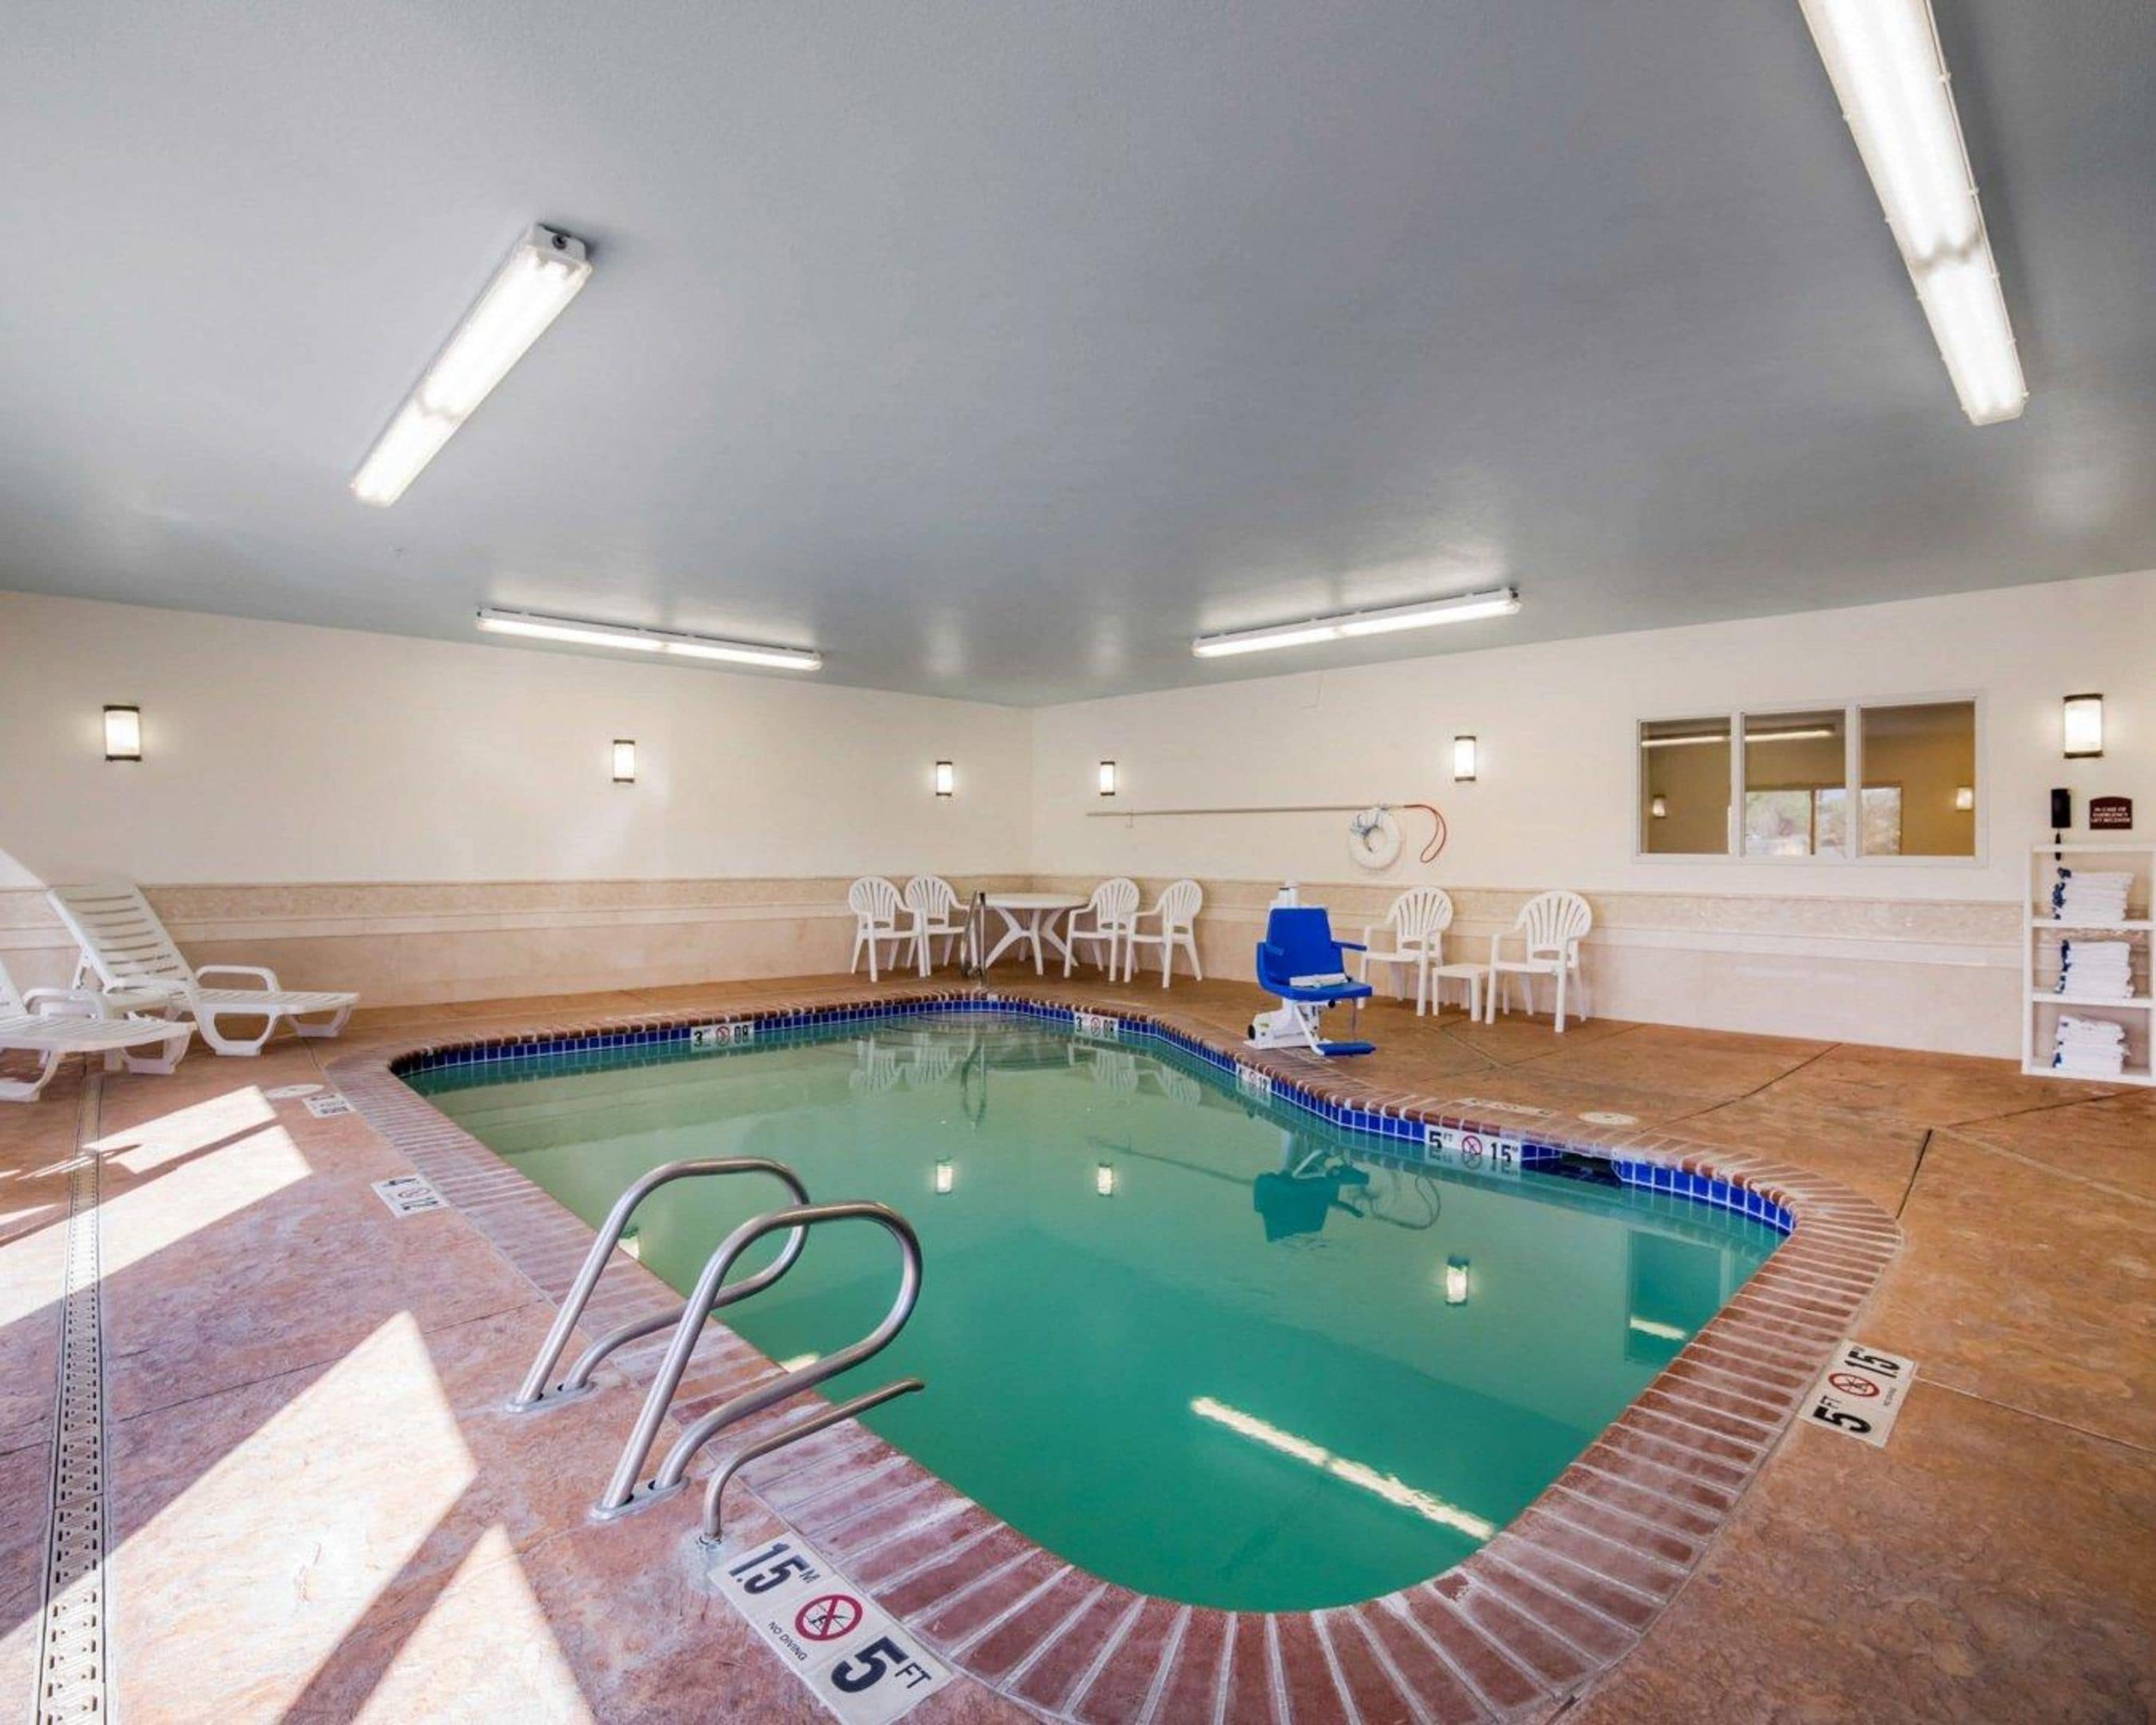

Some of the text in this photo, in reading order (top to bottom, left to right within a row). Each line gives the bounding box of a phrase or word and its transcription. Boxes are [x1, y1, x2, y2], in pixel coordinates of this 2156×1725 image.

[1429, 1131, 1443, 1149] 5
[1820, 1395, 1843, 1409] FT
[1812, 1405, 1872, 1433] 5
[767, 1621, 808, 1661] NO DIVING
[831, 1636, 909, 1693] 5
[895, 1661, 933, 1689] FT
